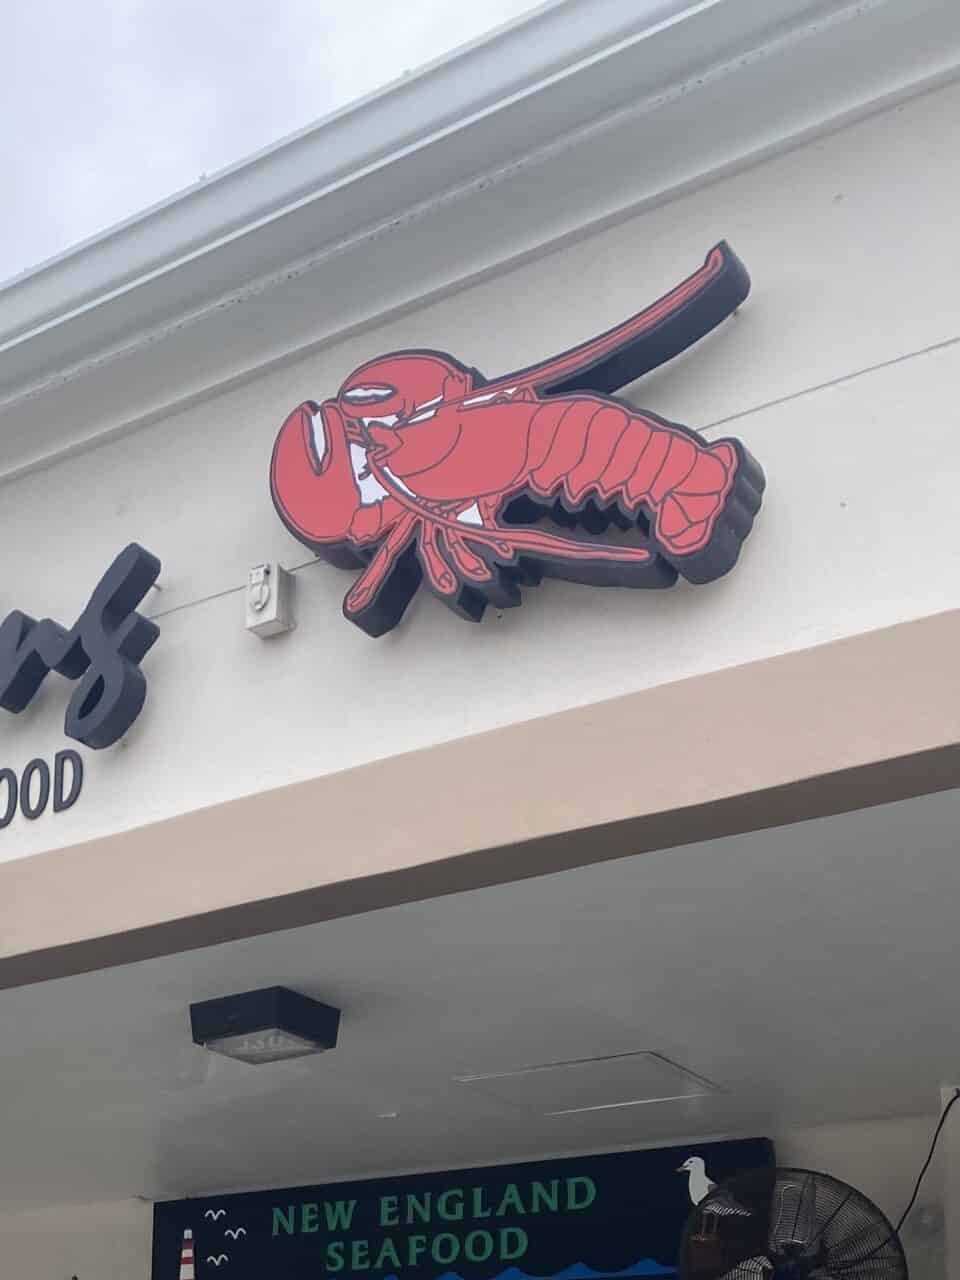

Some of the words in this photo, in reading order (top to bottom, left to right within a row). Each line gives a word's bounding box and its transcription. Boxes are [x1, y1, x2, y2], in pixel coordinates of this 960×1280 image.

[272, 1199, 357, 1236] NEW
[379, 1176, 597, 1226] ENGLAND
[326, 1227, 529, 1272] SEAFOOD
